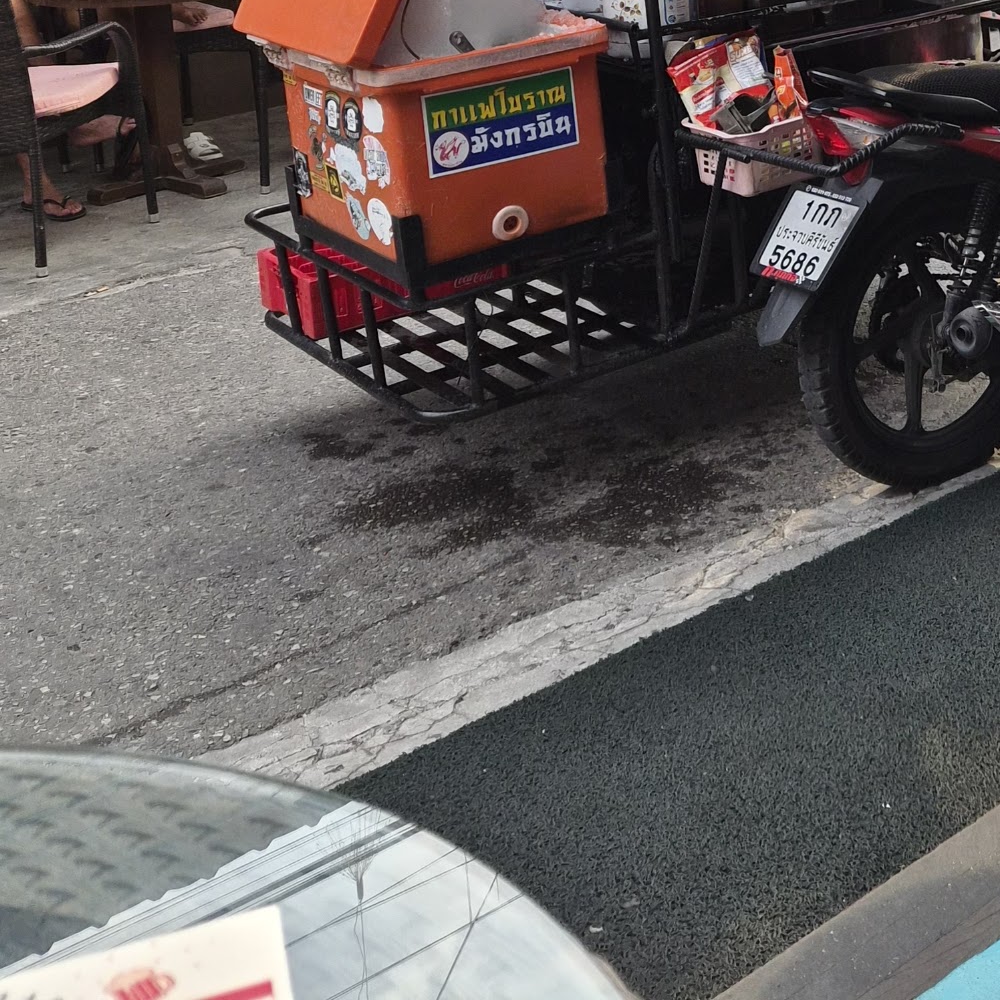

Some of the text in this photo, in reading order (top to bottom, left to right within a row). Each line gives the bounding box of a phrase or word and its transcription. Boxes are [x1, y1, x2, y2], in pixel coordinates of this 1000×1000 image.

[431, 85, 566, 130] กาแฟโบราณ
[471, 112, 572, 154] มังกรบิน
[776, 225, 840, 253] ประจวบคีรีขันธ์
[768, 244, 820, 277] 5686
